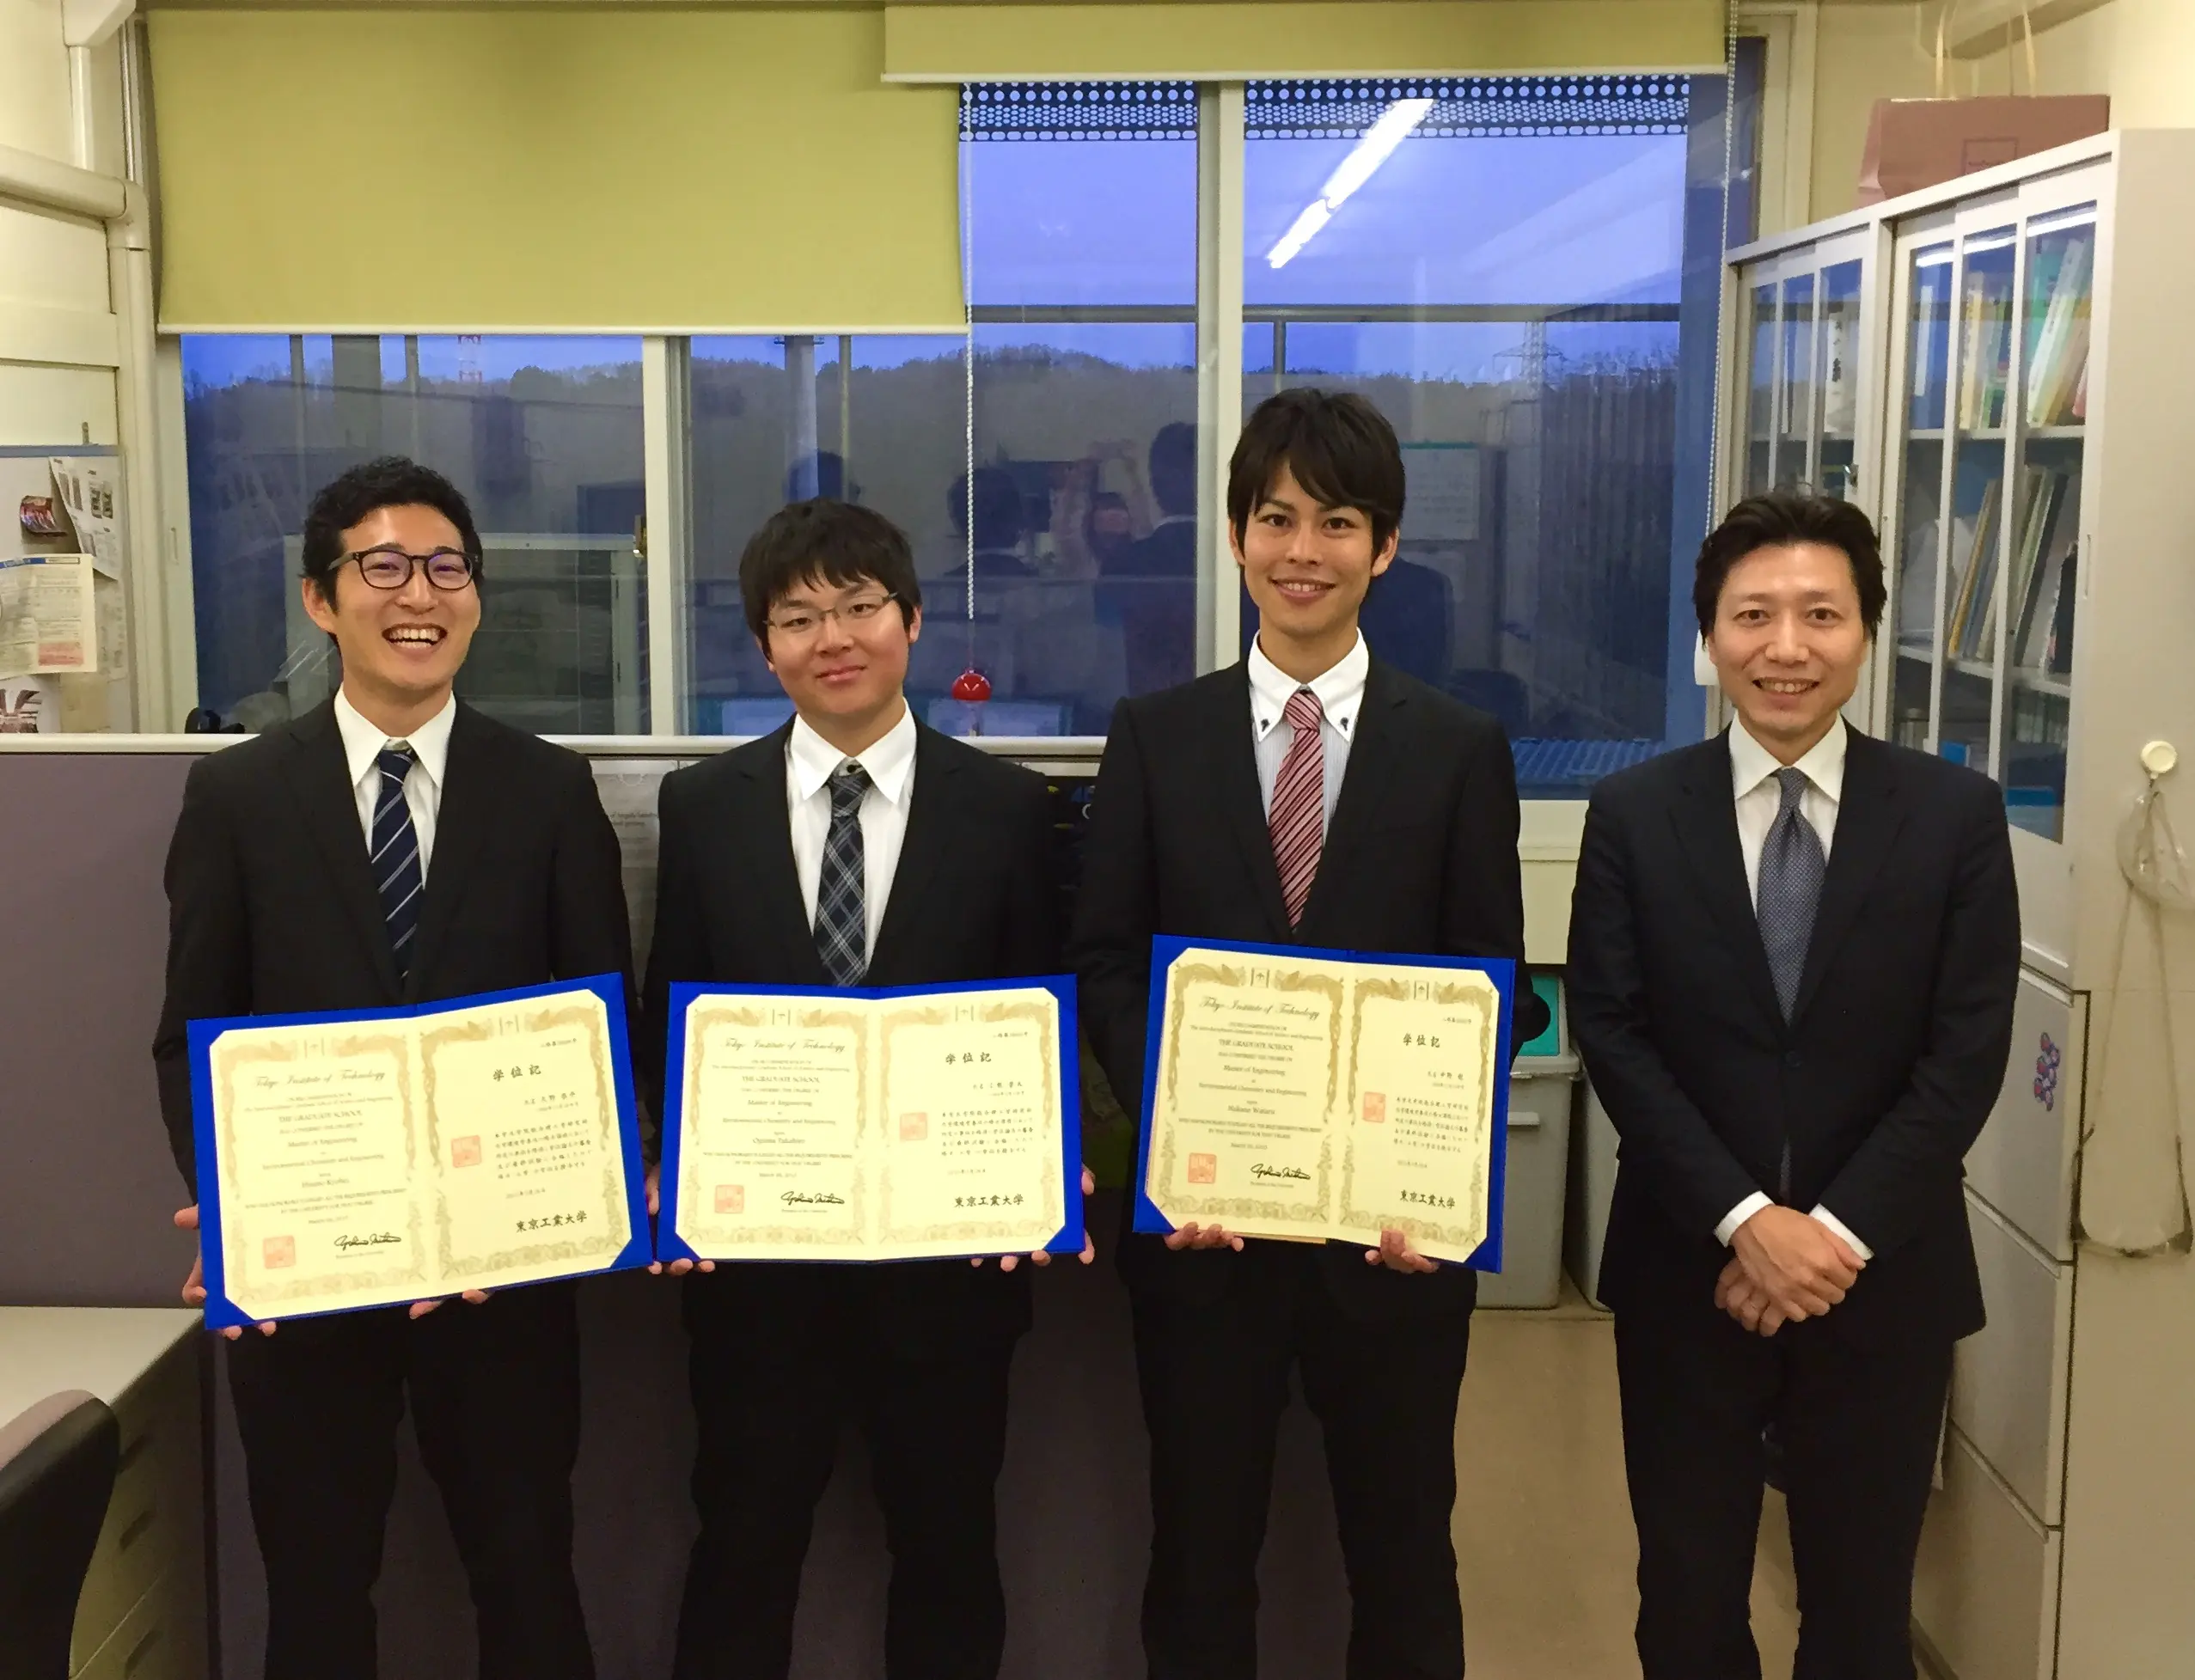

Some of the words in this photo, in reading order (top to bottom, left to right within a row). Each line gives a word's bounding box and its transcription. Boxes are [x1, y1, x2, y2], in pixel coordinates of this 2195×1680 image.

[1227, 999, 1263, 1011] Institute
[1263, 1005, 1273, 1015] of
[1275, 1002, 1321, 1021] Technology
[788, 1041, 798, 1050] of
[1403, 1032, 1440, 1048] 学位記
[945, 1051, 992, 1066] 学位記
[492, 1064, 541, 1082] 学位記
[954, 1193, 1024, 1208] 東京工業大学
[1399, 1189, 1456, 1210] 東京工業大学
[516, 1209, 587, 1233] 東京工業大学
